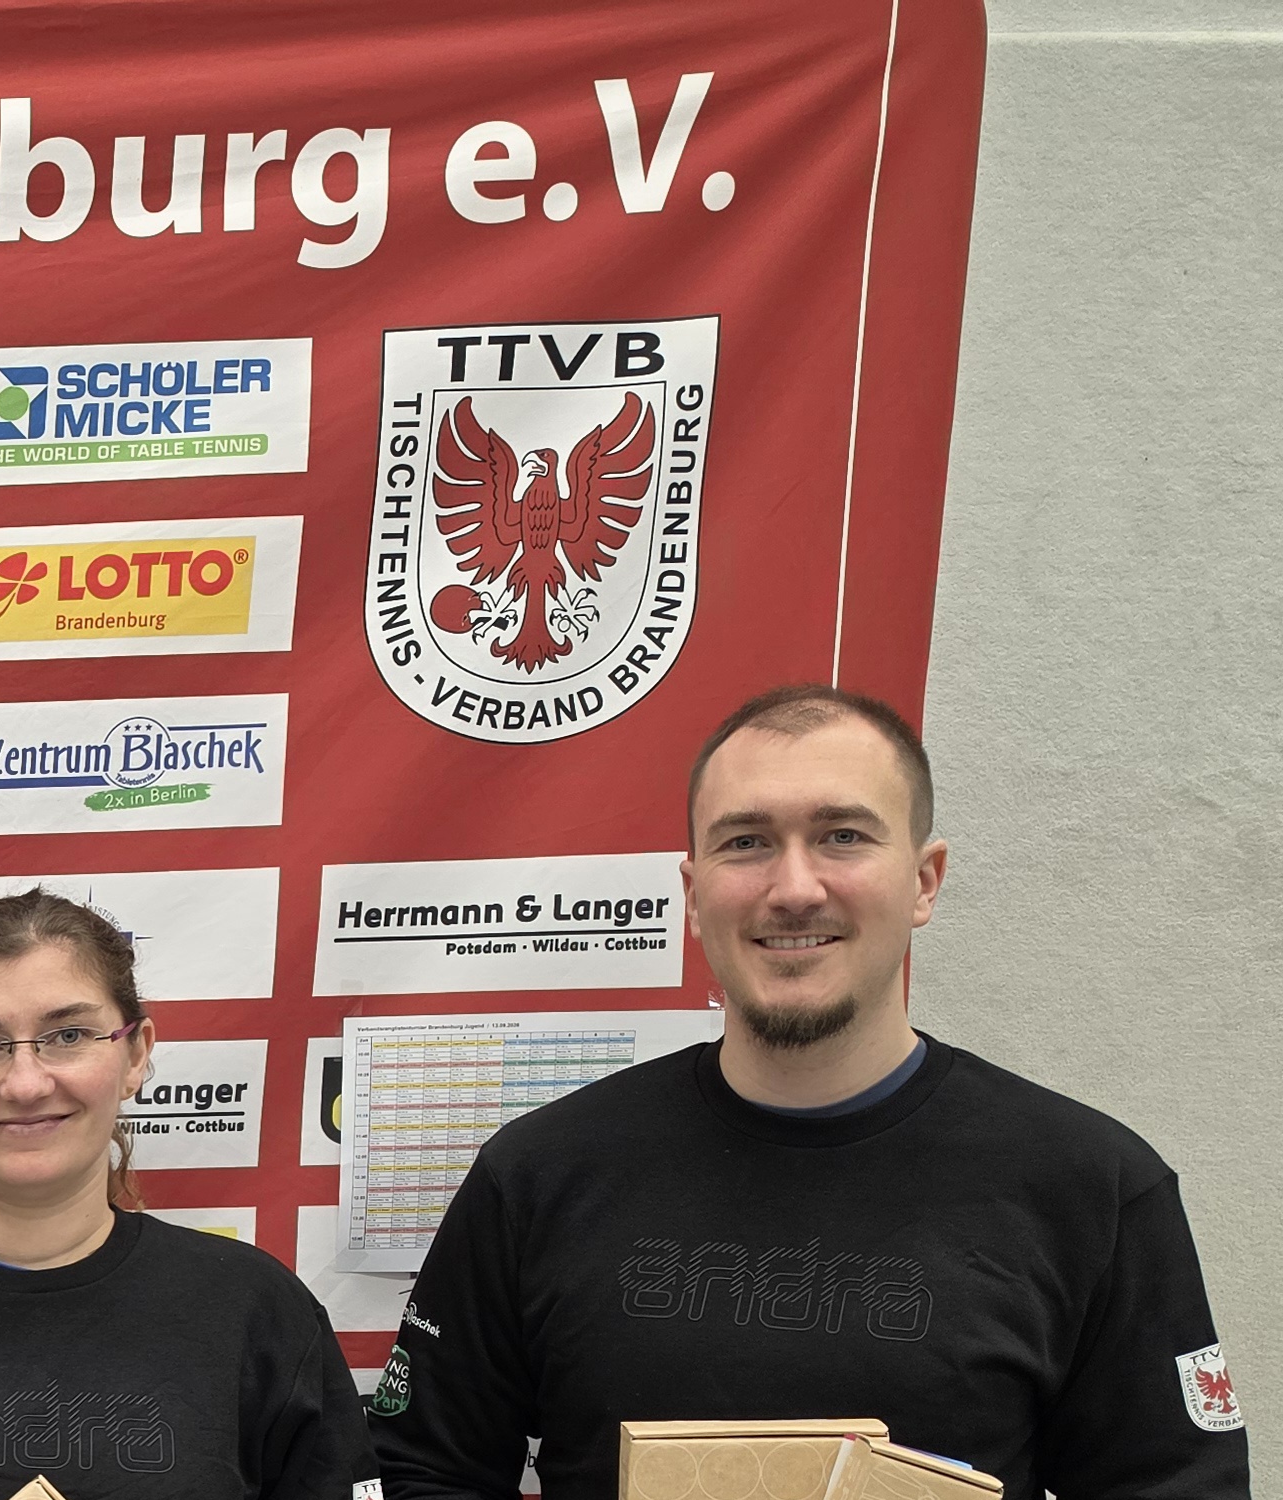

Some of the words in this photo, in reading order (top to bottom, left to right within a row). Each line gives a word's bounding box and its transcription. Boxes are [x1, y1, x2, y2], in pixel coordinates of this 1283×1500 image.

[445, 72, 736, 224] e.V.
[437, 331, 666, 382] TTVB
[56, 359, 271, 399] SCHÖLER
[54, 400, 211, 439] MICKE
[22, 444, 91, 462] WORLD
[98, 444, 120, 459] OF
[128, 440, 186, 458] TABLE
[193, 437, 261, 454] TENNIS
[371, 392, 423, 666] TISCHTENNIS
[430, 678, 604, 731] VERBAND
[608, 382, 704, 696] BRANDENBURG
[55, 609, 166, 632] Brandenburg
[120, 730, 264, 773] Blaschek
[104, 793, 124, 809] 2x
[130, 791, 144, 804] in
[151, 785, 197, 802] Berlin
[337, 901, 504, 929] Herrmann
[515, 895, 542, 922] &
[553, 894, 669, 926] Langer
[445, 942, 517, 956] Potsdam
[532, 939, 588, 953] Wildau
[604, 937, 667, 951] Cottbus
[135, 1079, 248, 1111] Langer
[184, 1119, 245, 1134] Cottbus
[1189, 1347, 1222, 1365] TTV
